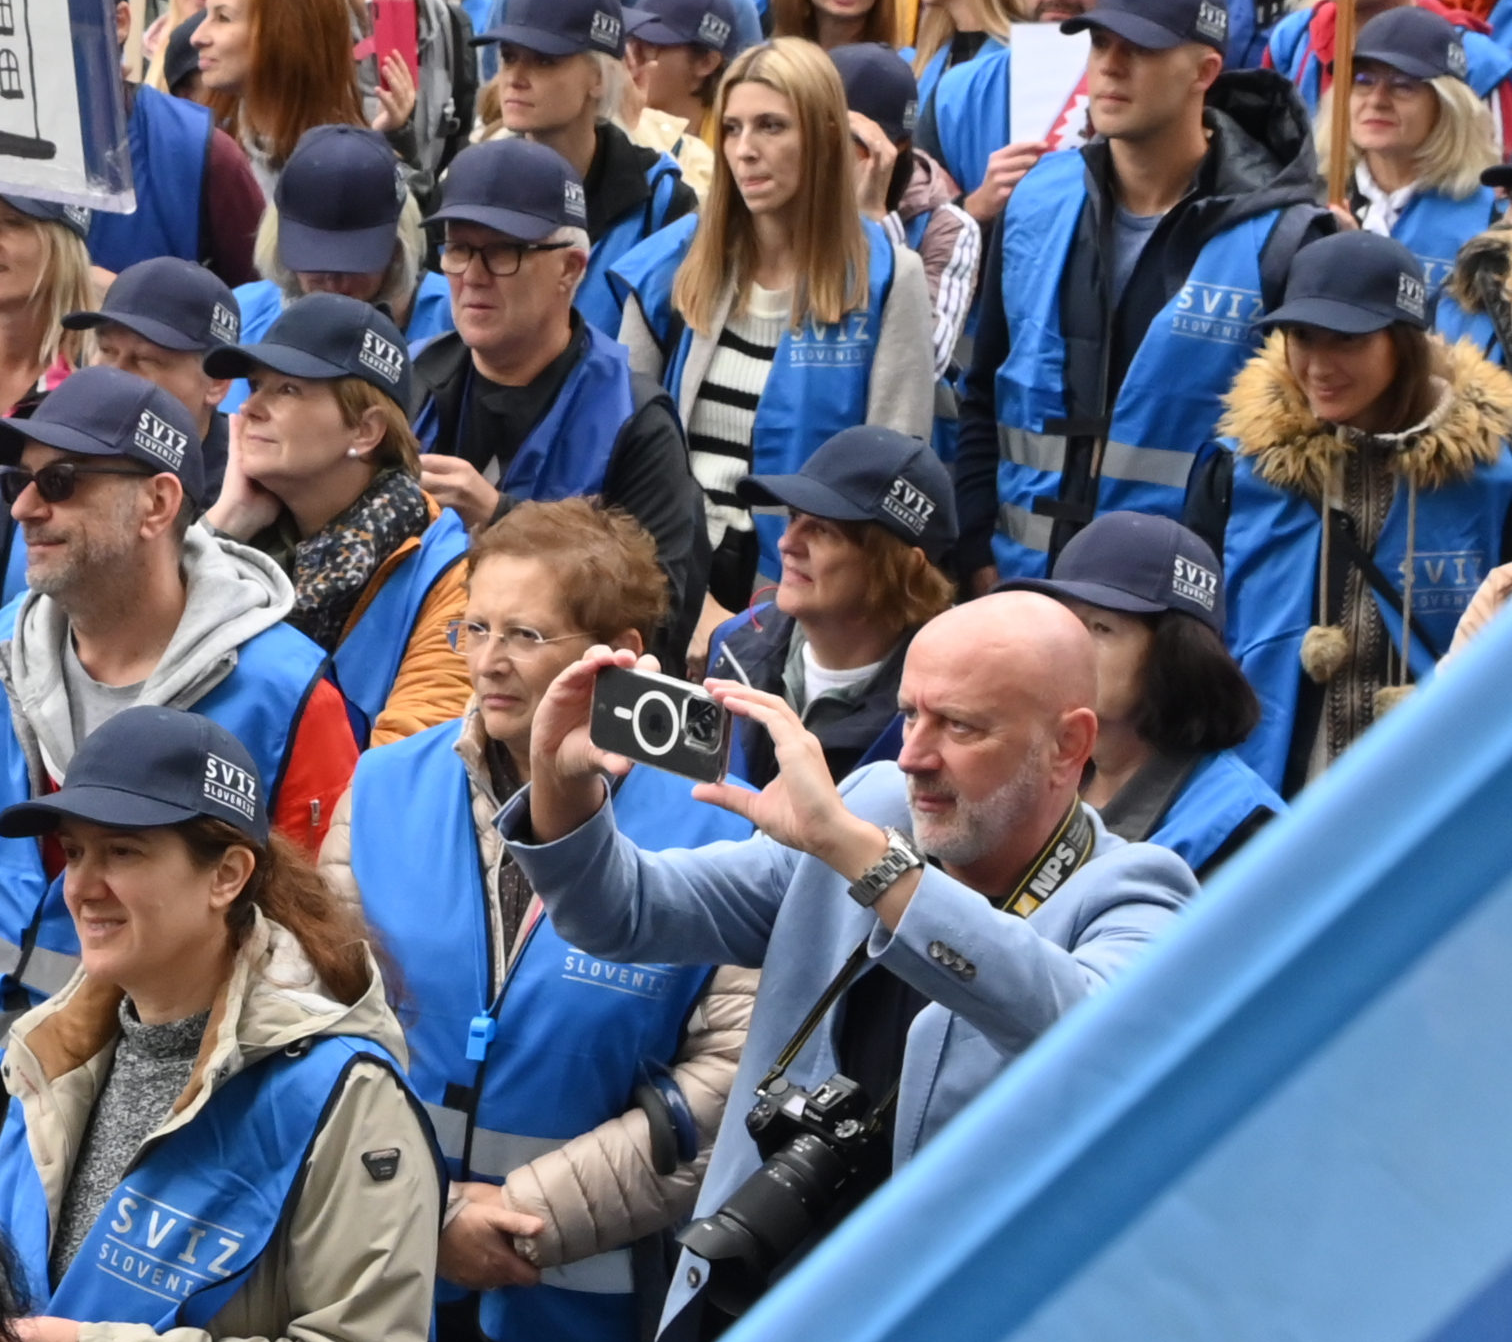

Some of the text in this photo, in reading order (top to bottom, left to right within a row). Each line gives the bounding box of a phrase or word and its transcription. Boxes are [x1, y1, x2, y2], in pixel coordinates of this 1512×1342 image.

[1177, 285, 1264, 322] SVIZ
[359, 350, 400, 384] SLOVENIJE
[363, 332, 404, 371] SVIZ
[134, 432, 182, 468] SLOVENIJE
[138, 412, 187, 456] SVIZ
[890, 479, 934, 522] SVIZ
[1174, 559, 1217, 595] SVIZ
[205, 757, 256, 800] SVIZ
[204, 783, 255, 817] SLOVENIJE
[1029, 842, 1076, 898] NPS
[111, 1197, 244, 1277] SVIZ
[98, 1242, 195, 1297] SLOVENI
